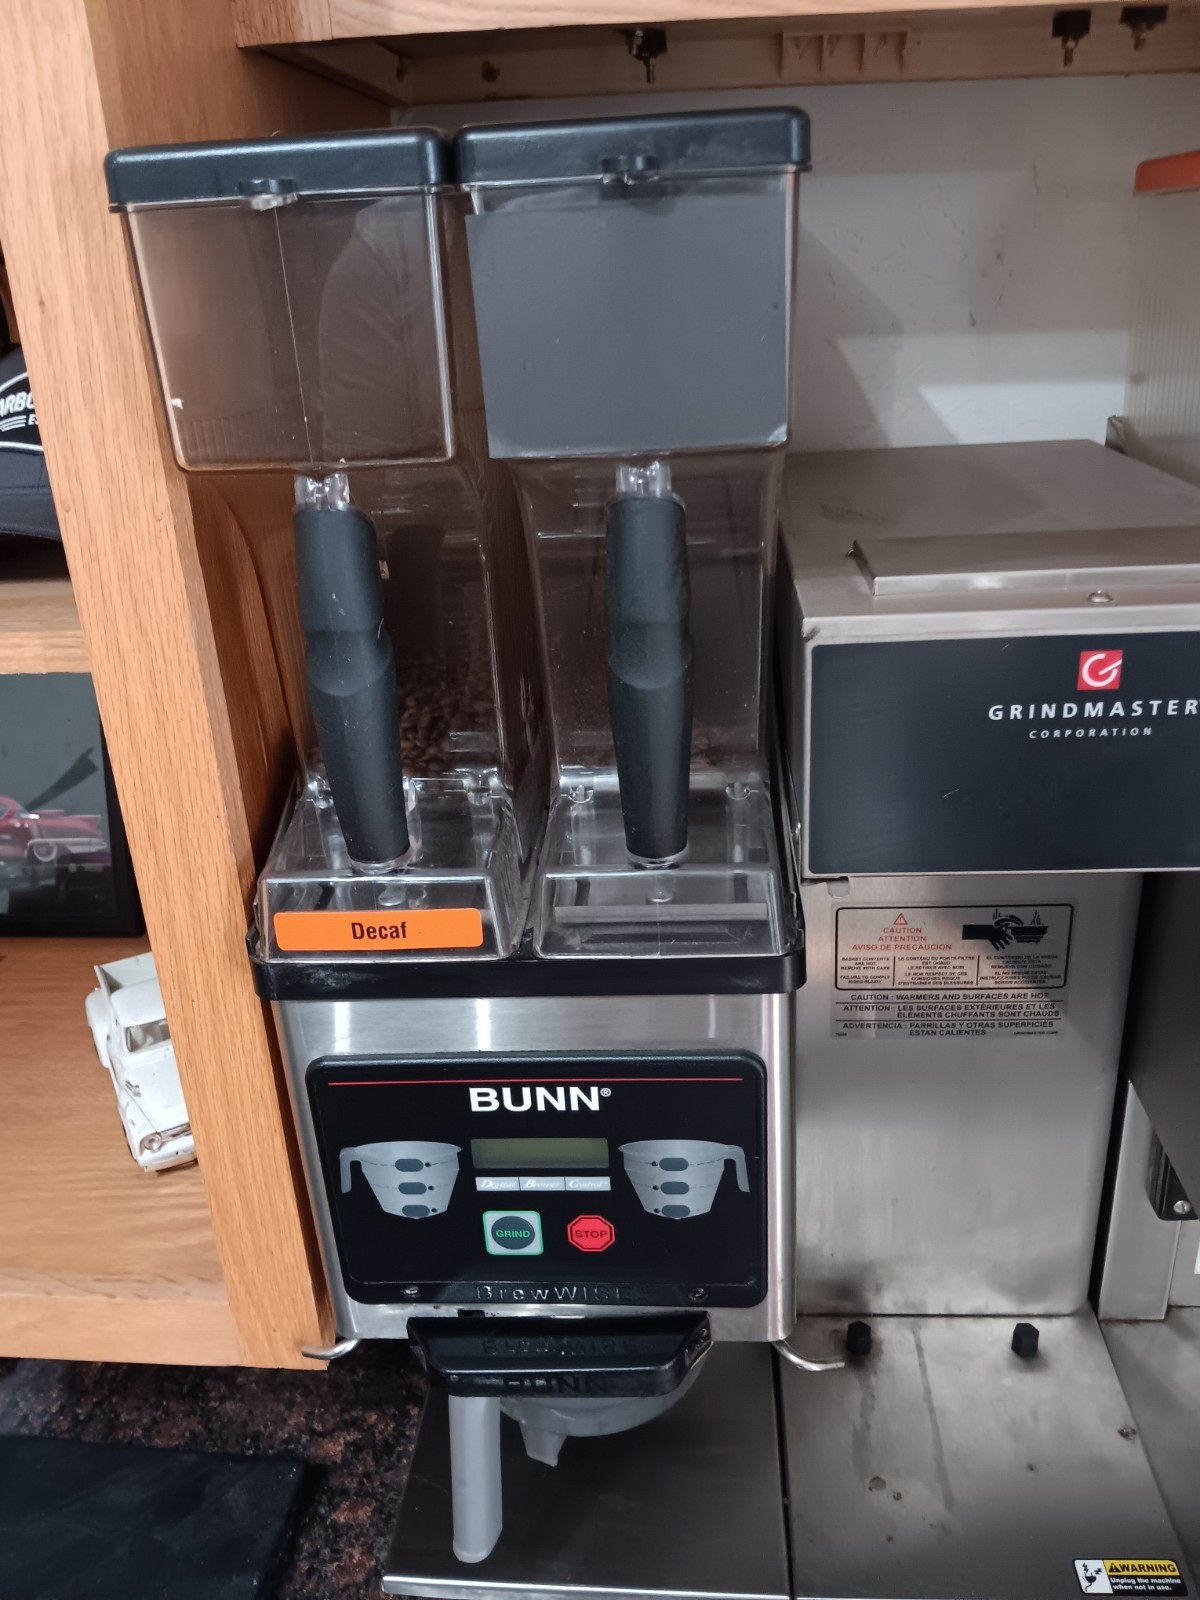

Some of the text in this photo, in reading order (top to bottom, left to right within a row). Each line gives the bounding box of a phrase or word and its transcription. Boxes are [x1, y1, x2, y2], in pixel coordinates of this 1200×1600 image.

[988, 700, 1199, 720] GRINDMASTER
[1029, 727, 1152, 739] CORPORATION
[351, 921, 407, 940] Decaf
[843, 1004, 890, 1012] ATTENTION
[897, 1004, 914, 1012] LES
[998, 1010, 1021, 1018] SONT
[496, 1230, 531, 1238] GRIND
[575, 1230, 607, 1239] STOP
[1119, 1563, 1176, 1573] WARNING
[1110, 1577, 1136, 1585] Unplug
